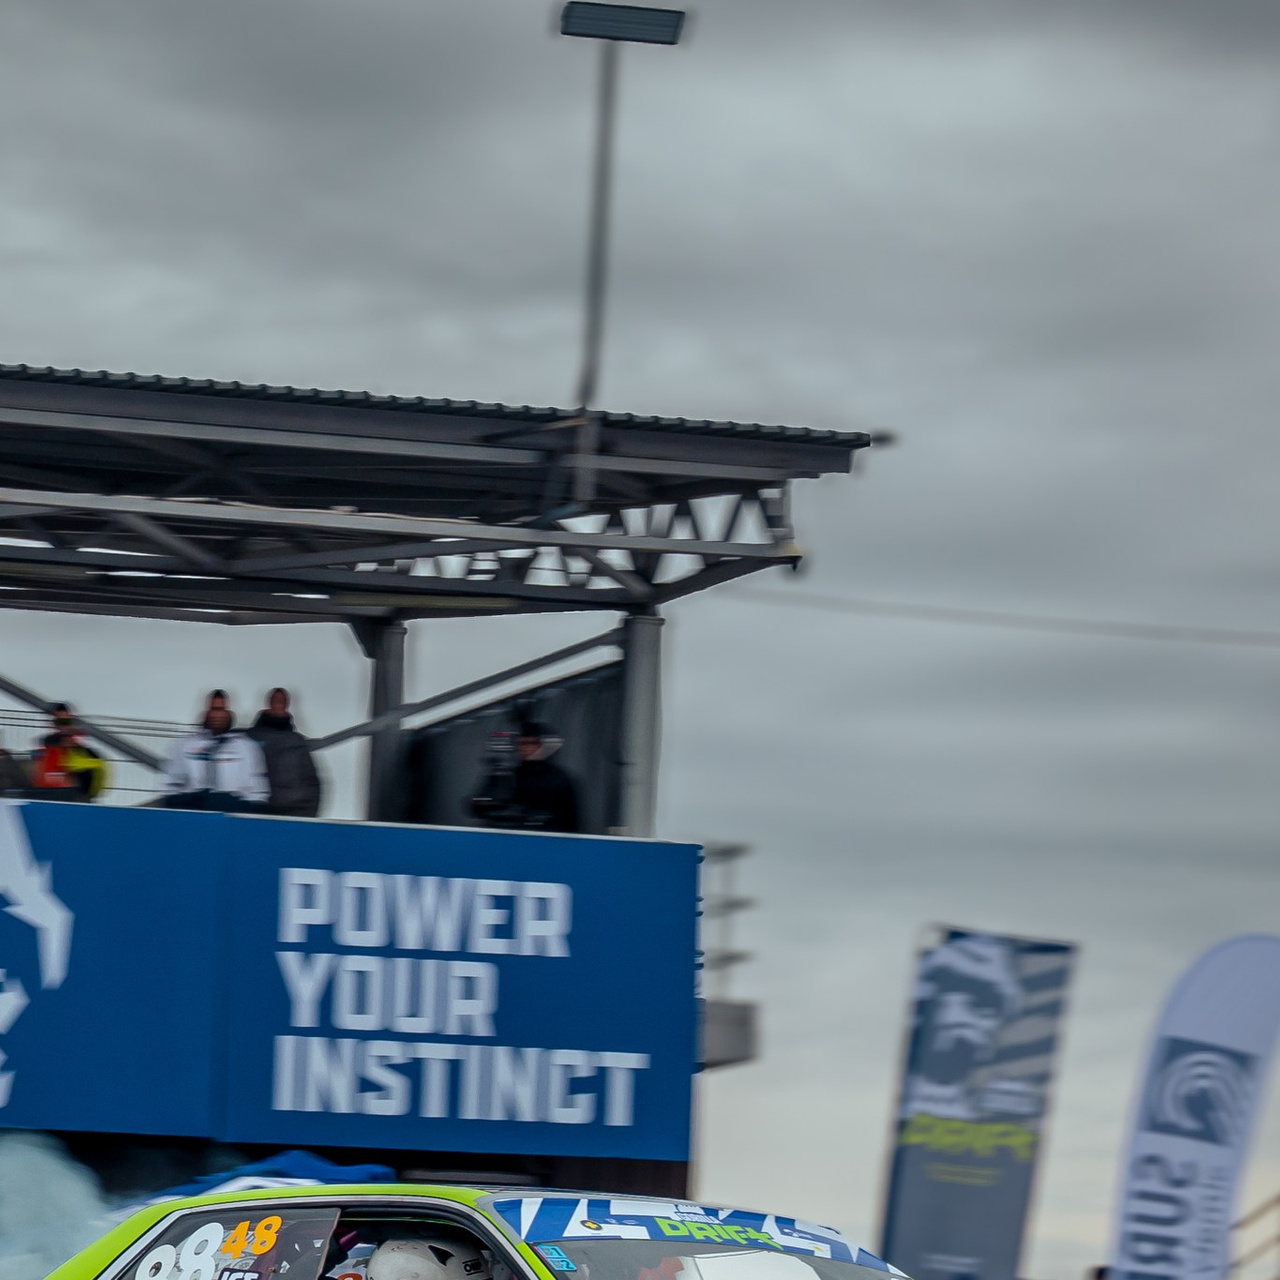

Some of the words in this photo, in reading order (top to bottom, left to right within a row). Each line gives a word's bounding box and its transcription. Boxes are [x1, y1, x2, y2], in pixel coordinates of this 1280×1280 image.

[277, 867, 573, 957] POWER
[275, 951, 499, 1036] YOUR
[272, 1035, 651, 1126] INSTINCT
[221, 1215, 282, 1259] 48
[654, 1217, 784, 1250] DRIFT
